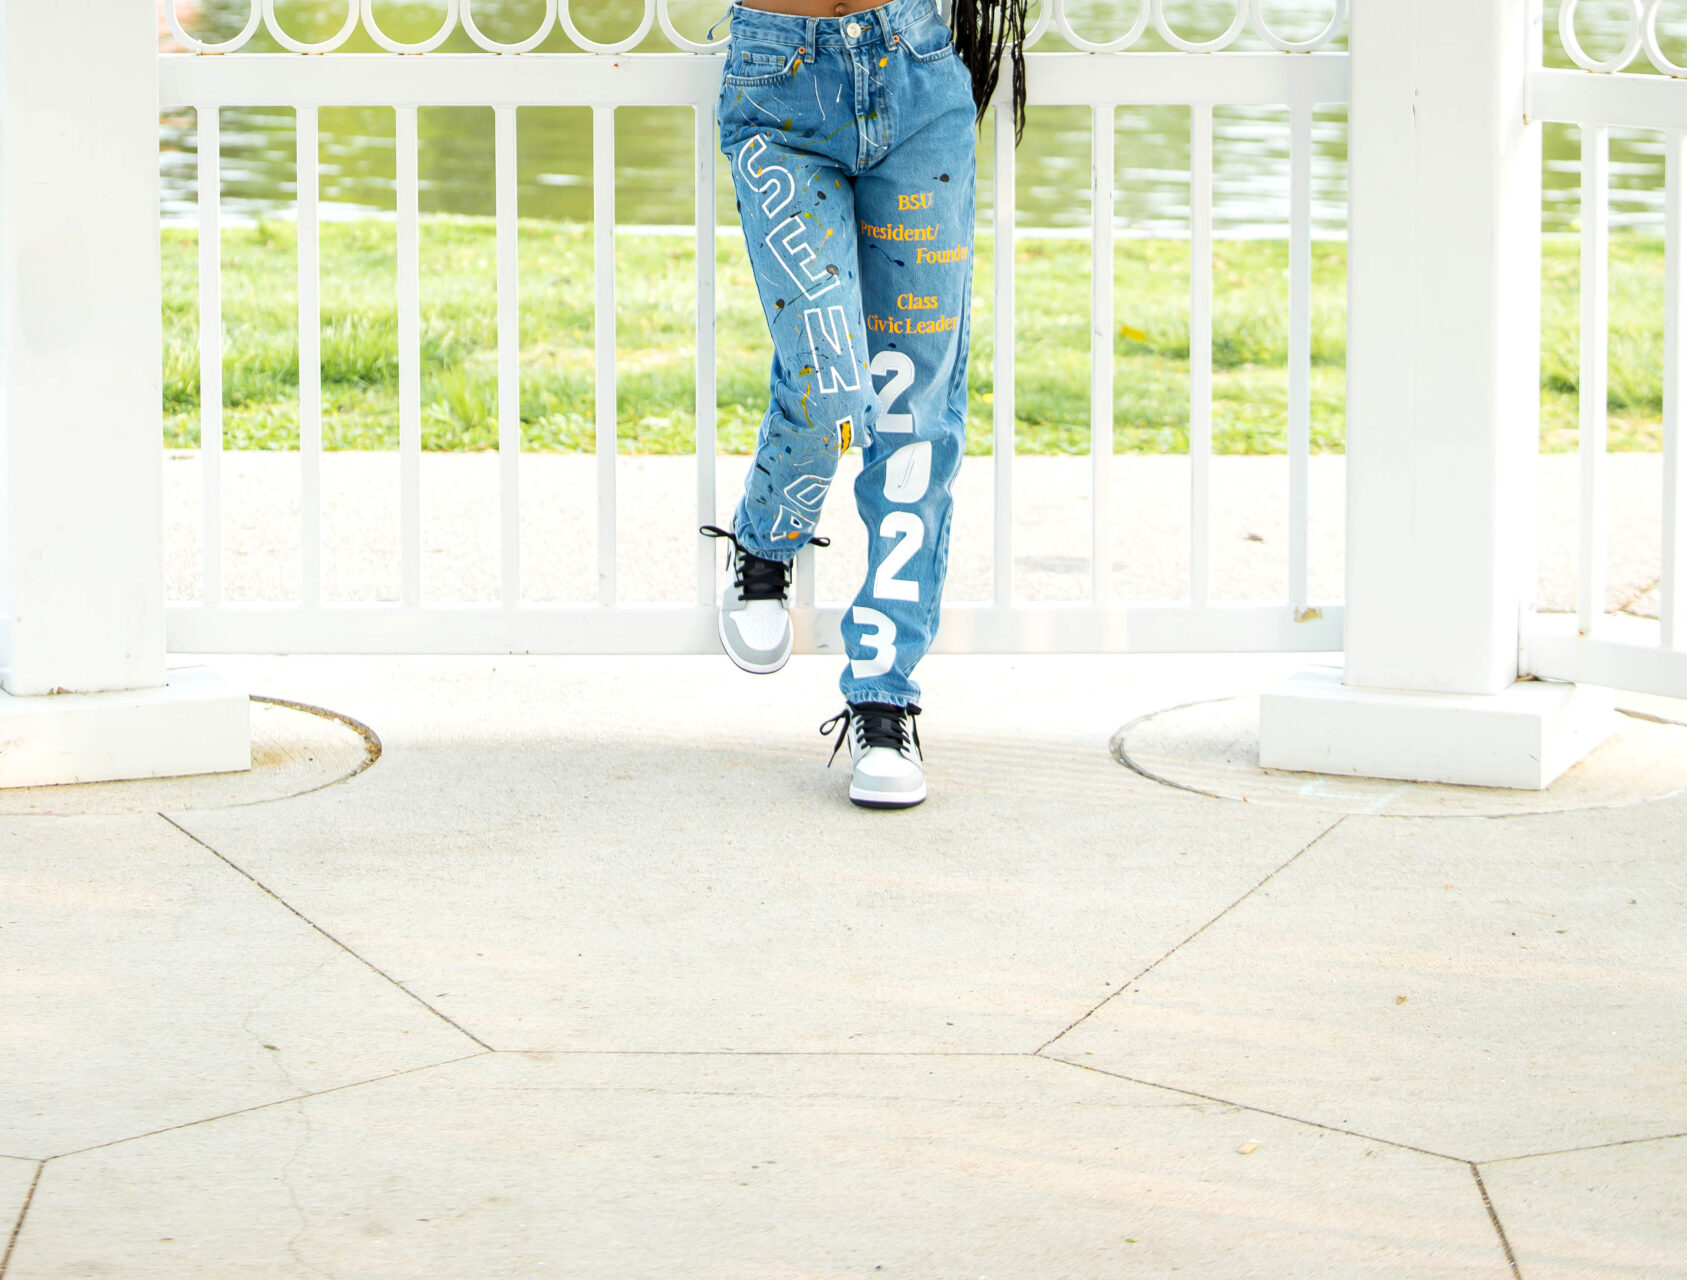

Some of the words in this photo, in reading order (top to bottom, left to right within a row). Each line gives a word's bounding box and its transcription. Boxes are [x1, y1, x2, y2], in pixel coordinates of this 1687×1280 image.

[897, 192, 933, 211] BSU
[861, 220, 939, 242] President/
[897, 293, 939, 310] Class
[867, 314, 904, 334] Civic
[904, 314, 958, 334] Leader
